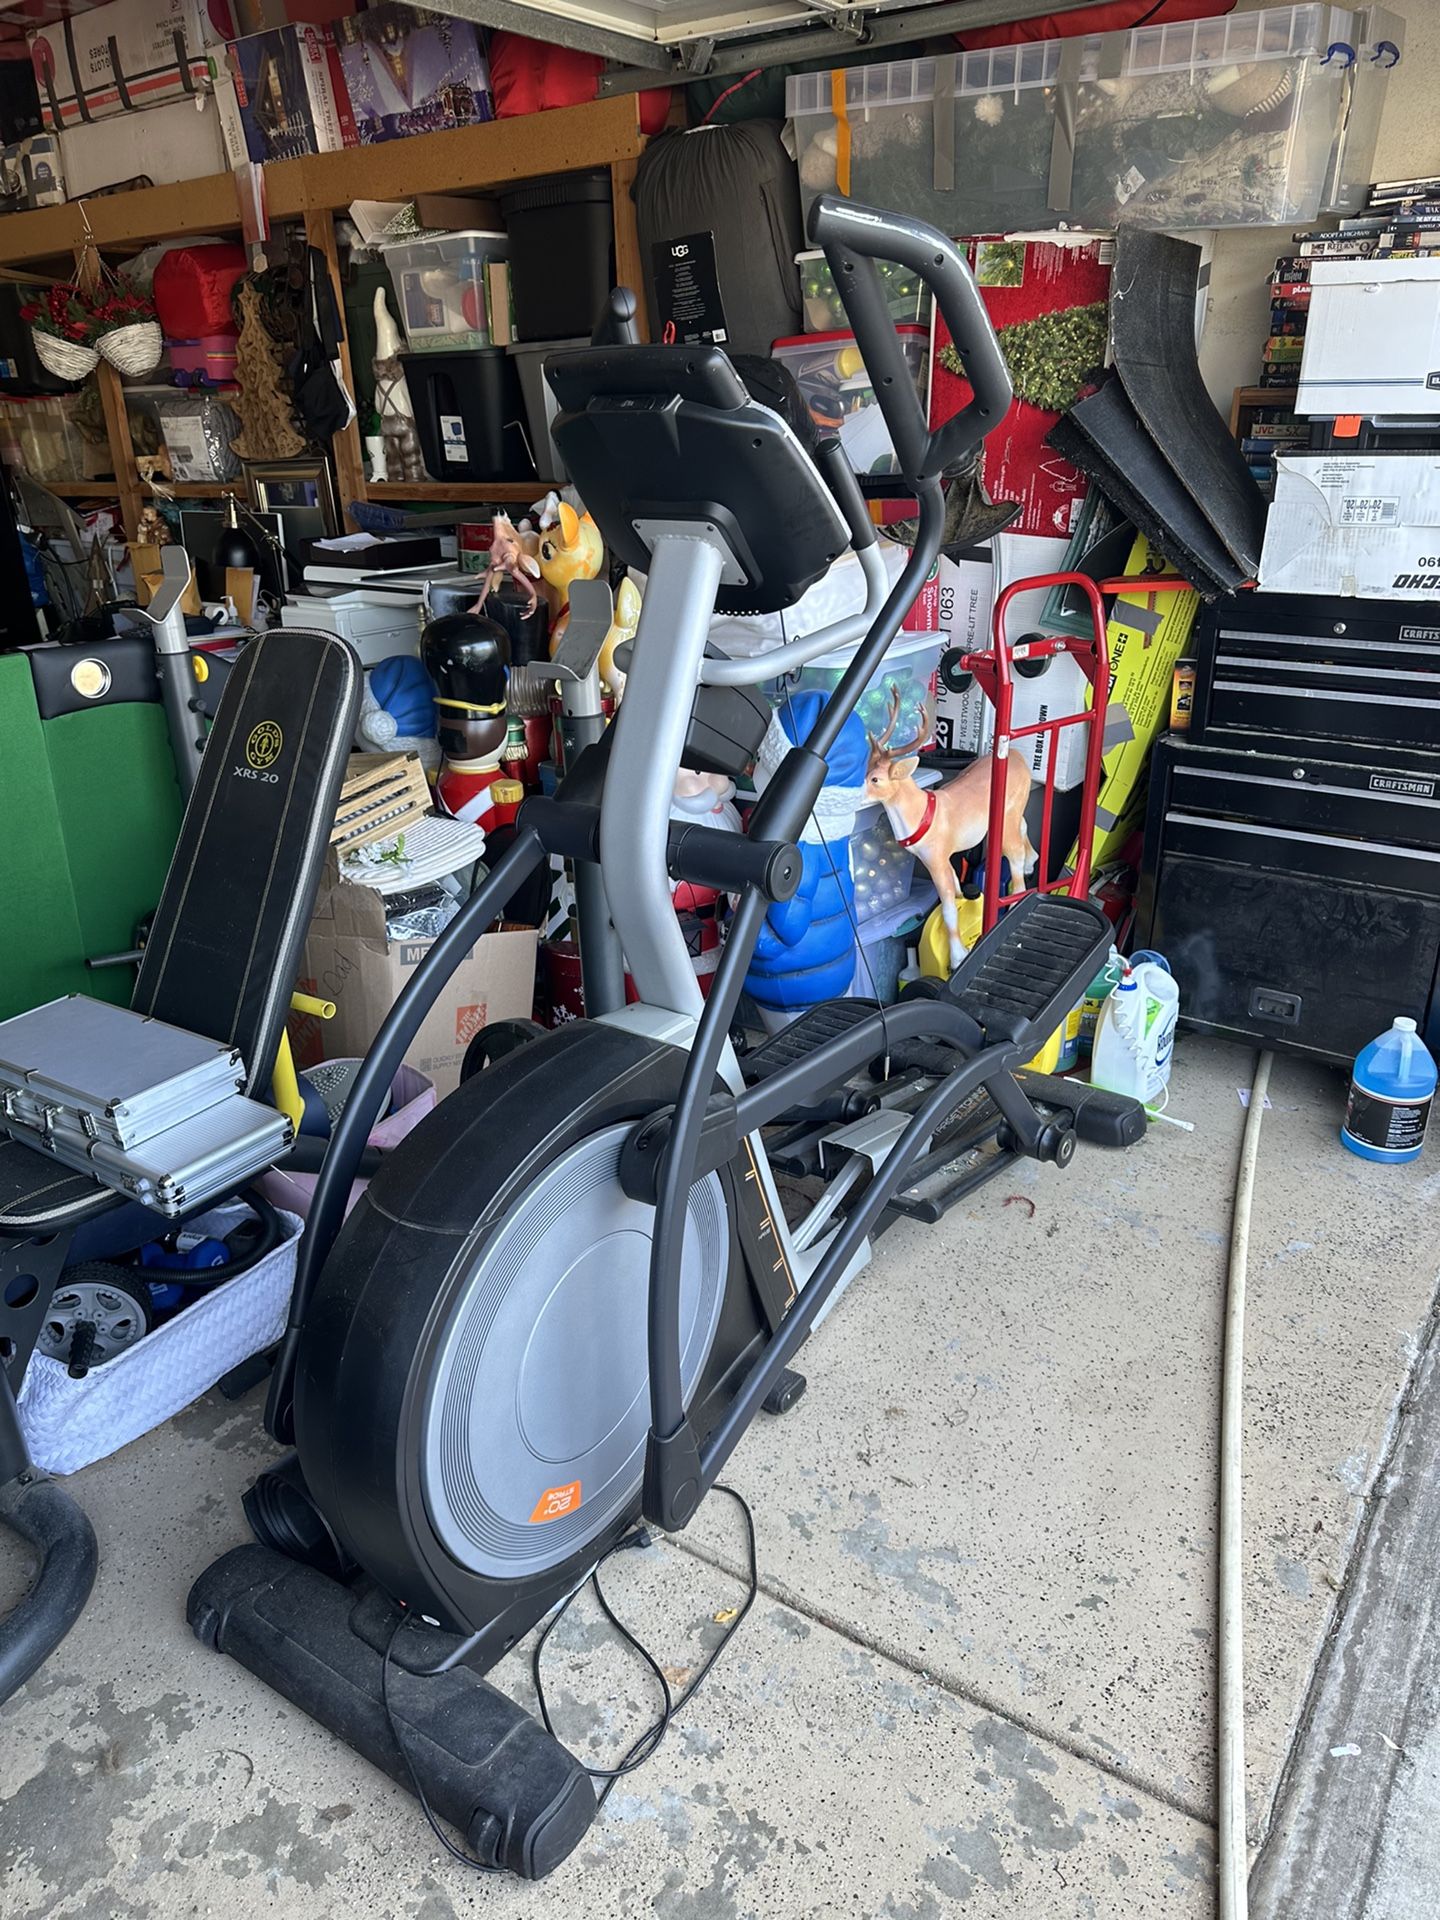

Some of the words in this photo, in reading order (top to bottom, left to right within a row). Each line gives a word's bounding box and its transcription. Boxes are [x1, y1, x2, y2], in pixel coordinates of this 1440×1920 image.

[89, 42, 109, 57] TORES
[318, 70, 329, 108] SPIRAL
[324, 109, 334, 135] TREE
[328, 137, 337, 151] SE
[671, 244, 689, 257] UGG
[1327, 242, 1354, 251] RETURN
[1255, 426, 1275, 434] JVC
[939, 586, 955, 621] 063
[968, 588, 979, 613] TREE
[926, 586, 934, 632] Snowm
[959, 690, 970, 737] WESTWOO
[250, 724, 280, 748] GOLD'S
[936, 720, 949, 749] 28
[959, 739, 966, 750] FT
[1034, 739, 1044, 754] BOX
[250, 751, 274, 765] GYM
[1032, 755, 1042, 771] TREE
[233, 766, 258, 779] XRS
[260, 772, 279, 784] 20
[1373, 778, 1431, 794] CRAFTSMAN
[547, 1486, 575, 1501] STRIDE
